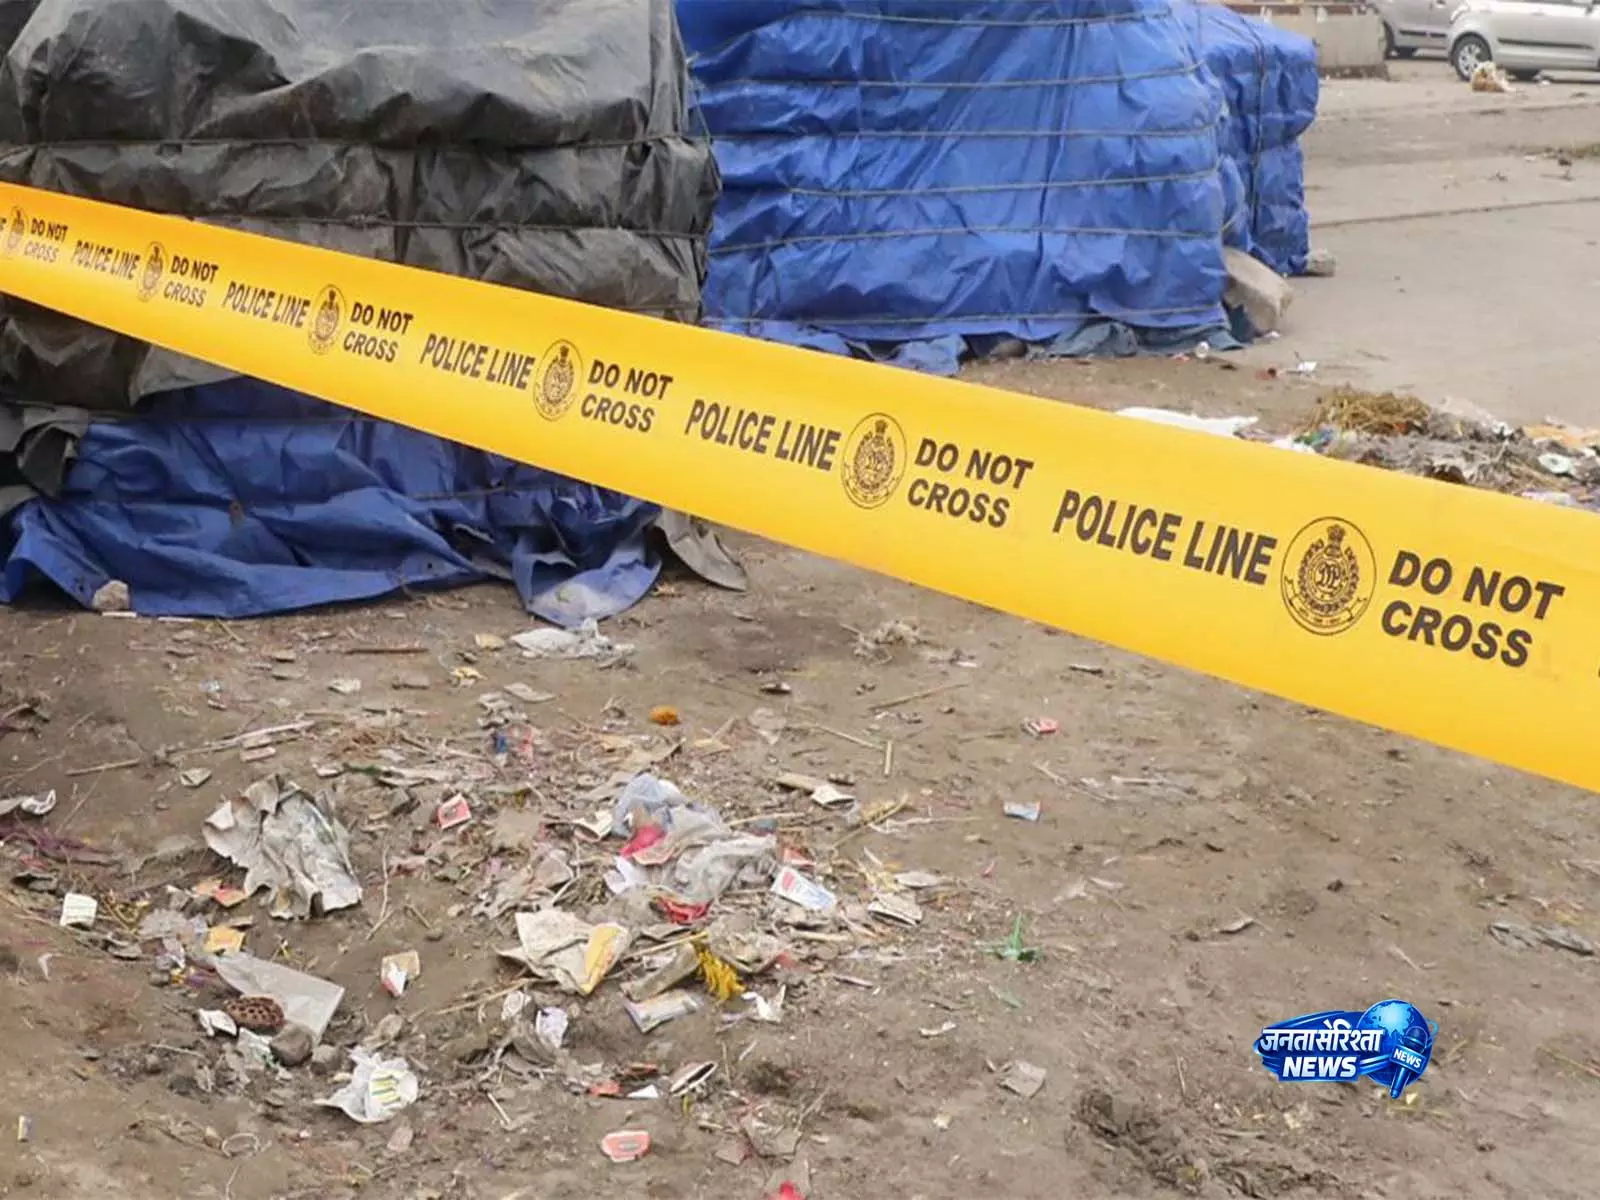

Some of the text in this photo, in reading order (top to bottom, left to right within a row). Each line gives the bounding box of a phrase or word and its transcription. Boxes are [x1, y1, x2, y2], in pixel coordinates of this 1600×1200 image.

[30, 218, 46, 236] DO
[47, 221, 69, 243] NOT
[24, 241, 60, 263] CROSS
[72, 240, 141, 280] POLICE LINE
[170, 255, 219, 284] DO NOT
[163, 281, 207, 308] CROSS
[222, 281, 311, 328] POLICE LINE
[350, 301, 414, 336] DO NOT
[342, 330, 399, 363] CROSS
[419, 332, 536, 390] POLICE LINE
[587, 359, 674, 401] DO NOT
[581, 393, 656, 433] CROSS
[684, 398, 842, 472] POLICE LINE
[914, 437, 1035, 490] DO NOT
[907, 478, 1010, 529] CROSS
[1052, 489, 1183, 562] POLICE
[1183, 520, 1278, 586] LINE
[1388, 550, 1453, 596] DO
[1462, 566, 1566, 620] NOT
[1381, 599, 1533, 668] CROSS
